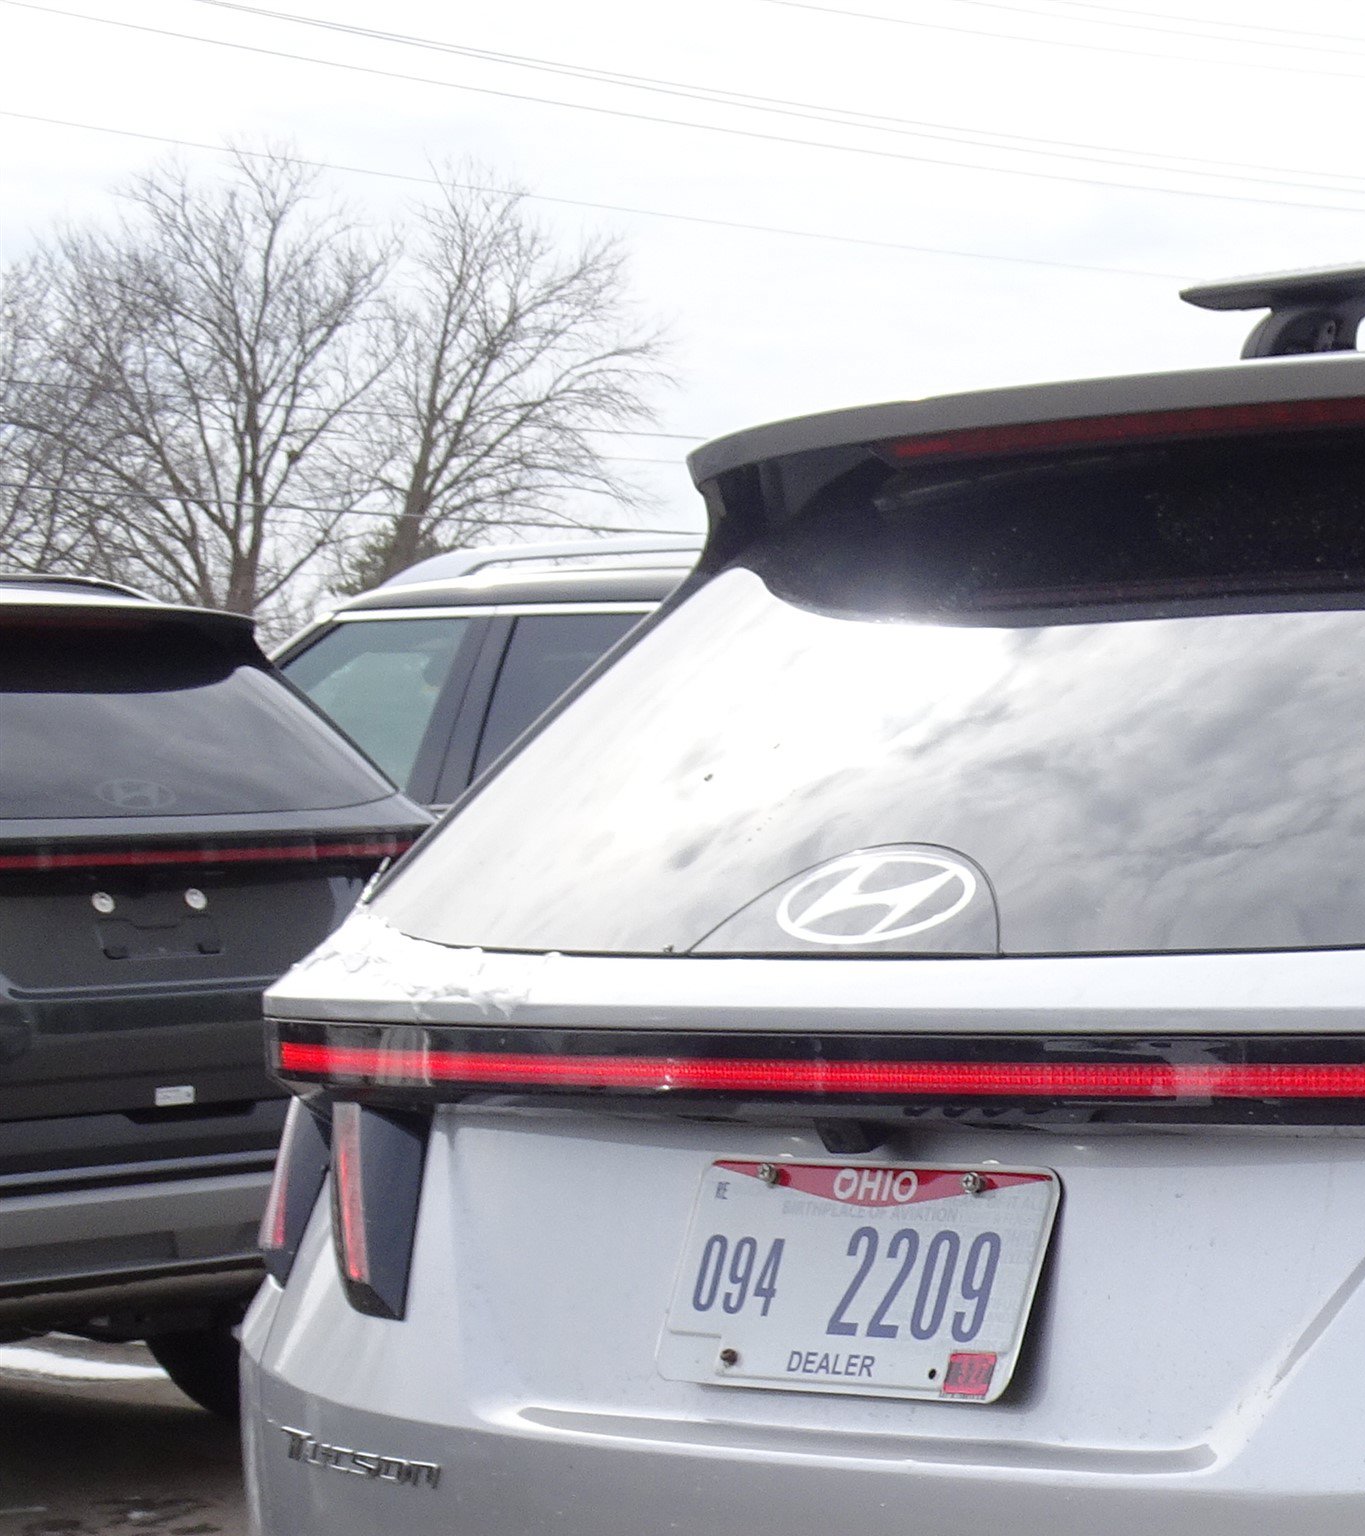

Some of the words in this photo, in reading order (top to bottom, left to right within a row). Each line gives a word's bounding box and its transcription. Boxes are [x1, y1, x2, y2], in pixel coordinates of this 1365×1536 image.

[833, 1168, 919, 1202] OHIO
[693, 1234, 786, 1317] 094
[826, 1226, 1001, 1343] 2209
[786, 1351, 875, 1378] DEALER
